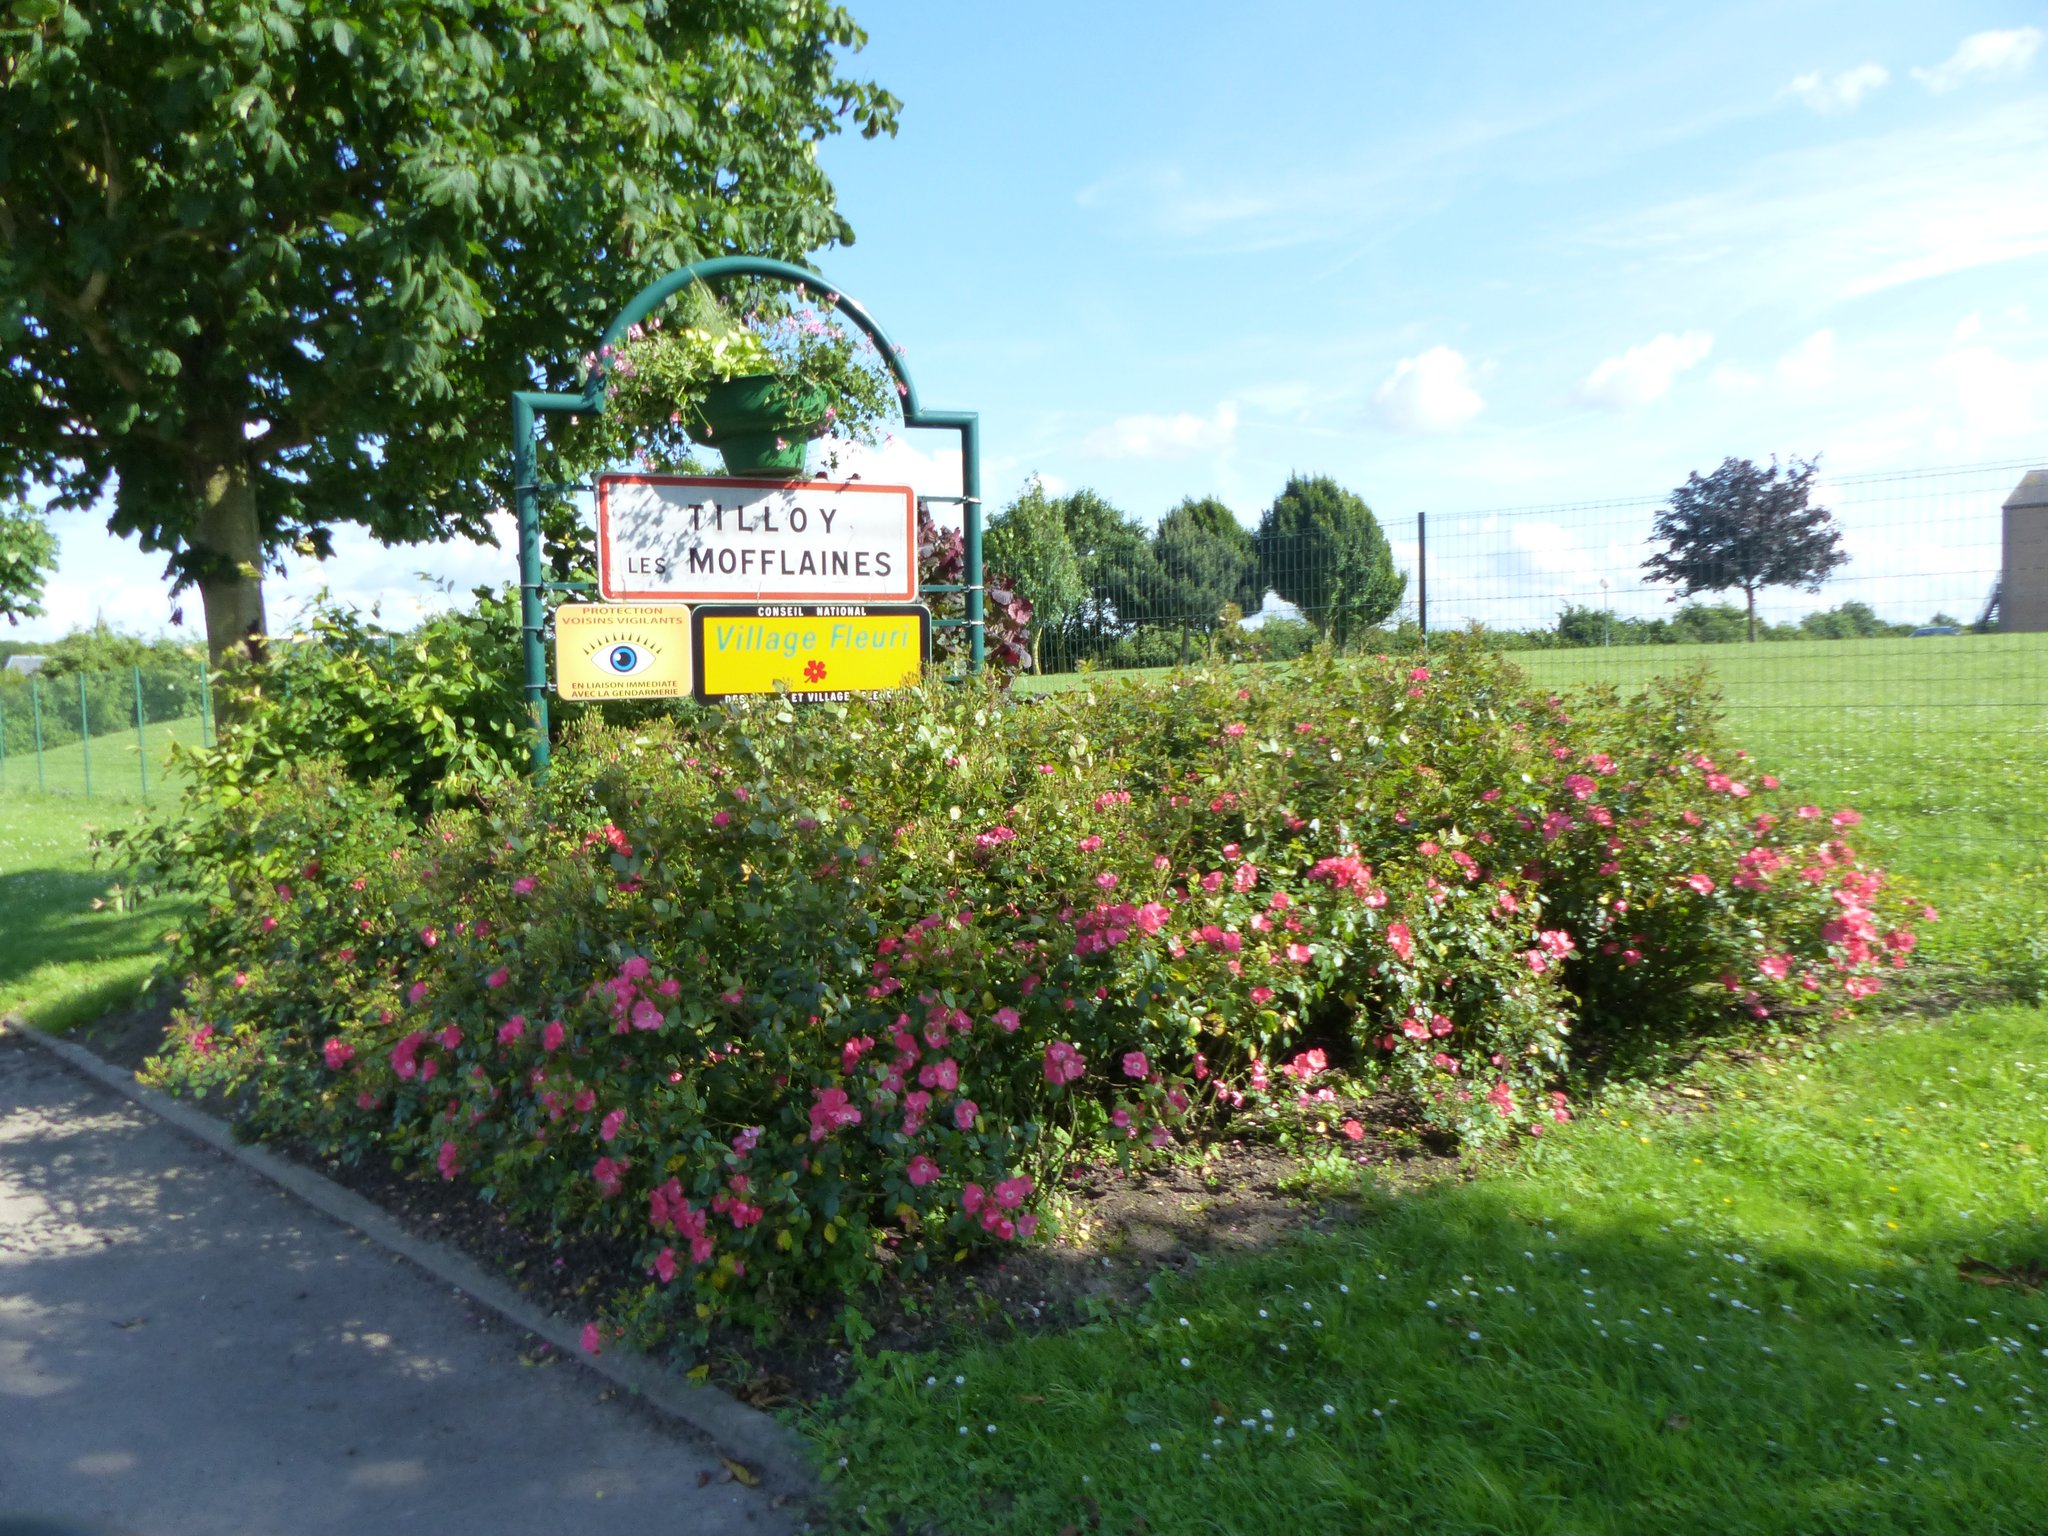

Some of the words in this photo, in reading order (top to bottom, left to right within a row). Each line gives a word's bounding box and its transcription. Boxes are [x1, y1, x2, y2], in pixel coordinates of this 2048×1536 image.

[688, 504, 837, 533] TILLOY
[628, 557, 667, 574] LES
[689, 548, 892, 577] MOFFLAINES
[562, 617, 614, 625] VOISINS
[617, 617, 683, 625] VIGILANTS
[757, 607, 804, 617] CONSEIL
[816, 606, 867, 616] NATIONAL
[717, 625, 817, 659] Village
[830, 624, 910, 649] Fleuri
[791, 693, 804, 703] ET
[807, 691, 851, 702] VILLAGE
